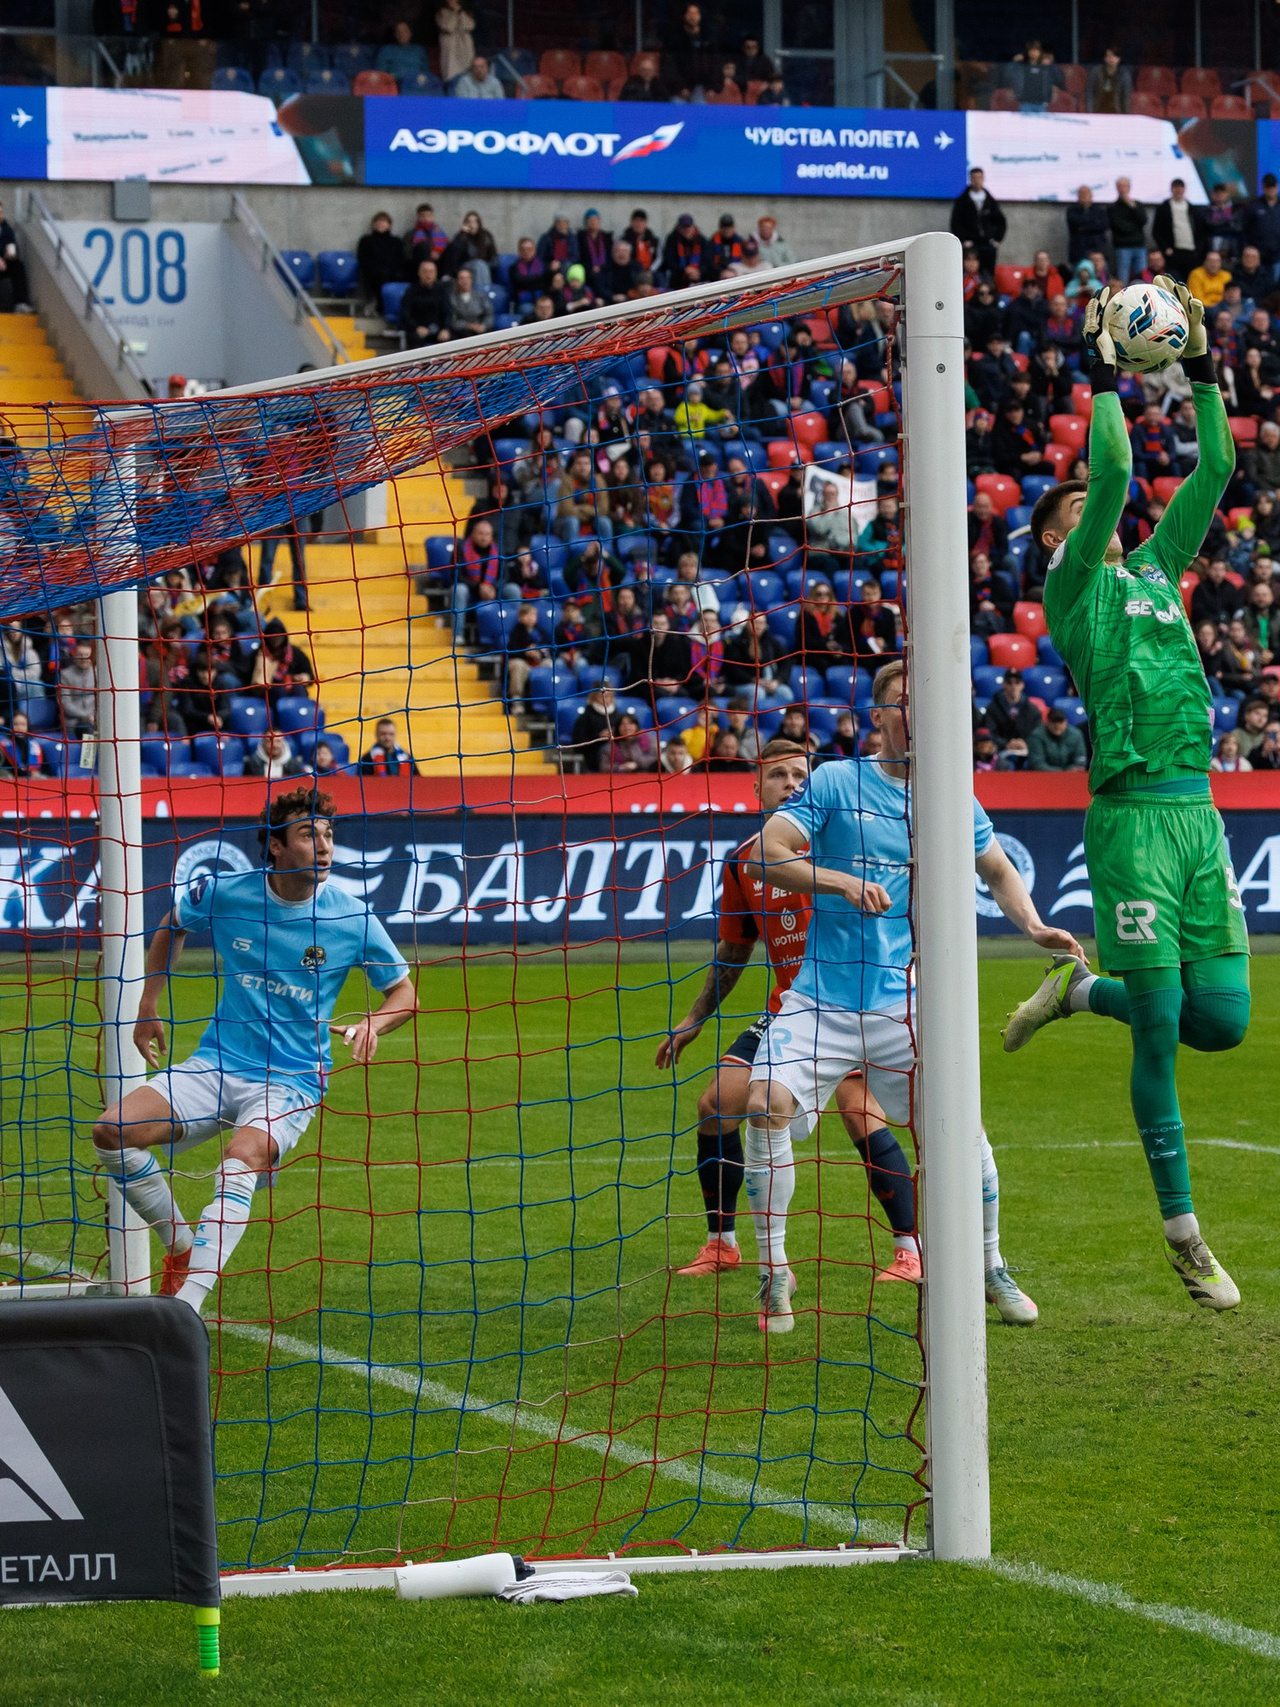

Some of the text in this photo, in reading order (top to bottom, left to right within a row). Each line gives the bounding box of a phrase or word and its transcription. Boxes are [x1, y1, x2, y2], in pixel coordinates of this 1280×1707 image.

[389, 128, 621, 157] АЭРОФЛОТ
[744, 126, 920, 149] ЧУВСТВА ПОЛЕТА
[796, 161, 888, 181] aeroflot.ru
[75, 228, 187, 305] 208
